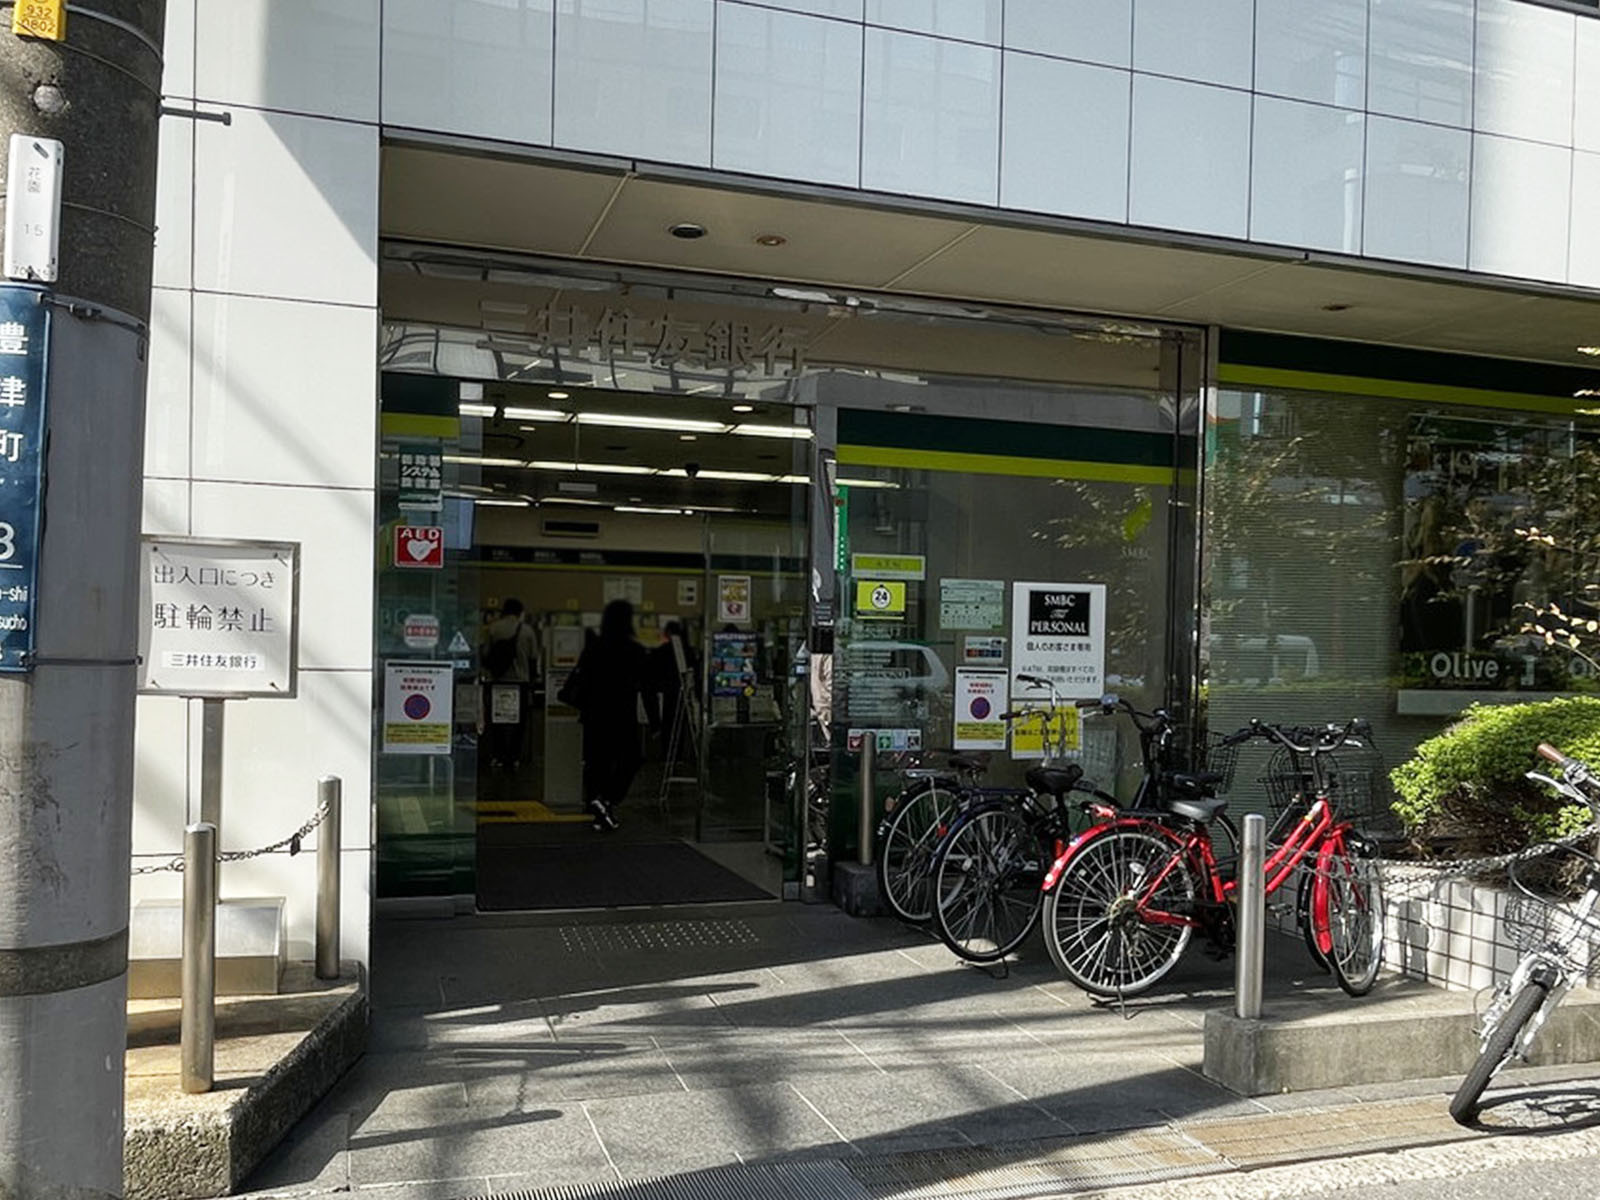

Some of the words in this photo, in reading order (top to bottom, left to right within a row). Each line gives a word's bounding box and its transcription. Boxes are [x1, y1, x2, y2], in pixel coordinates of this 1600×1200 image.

[154, 564, 275, 589] 出入口につき
[874, 590, 888, 602] 24
[1044, 594, 1076, 608] SMBC
[154, 603, 277, 632] 駐輪禁止
[1031, 620, 1087, 634] PERSONAL
[171, 654, 257, 669] 三井住友銀行
[1431, 652, 1499, 679] Olive
